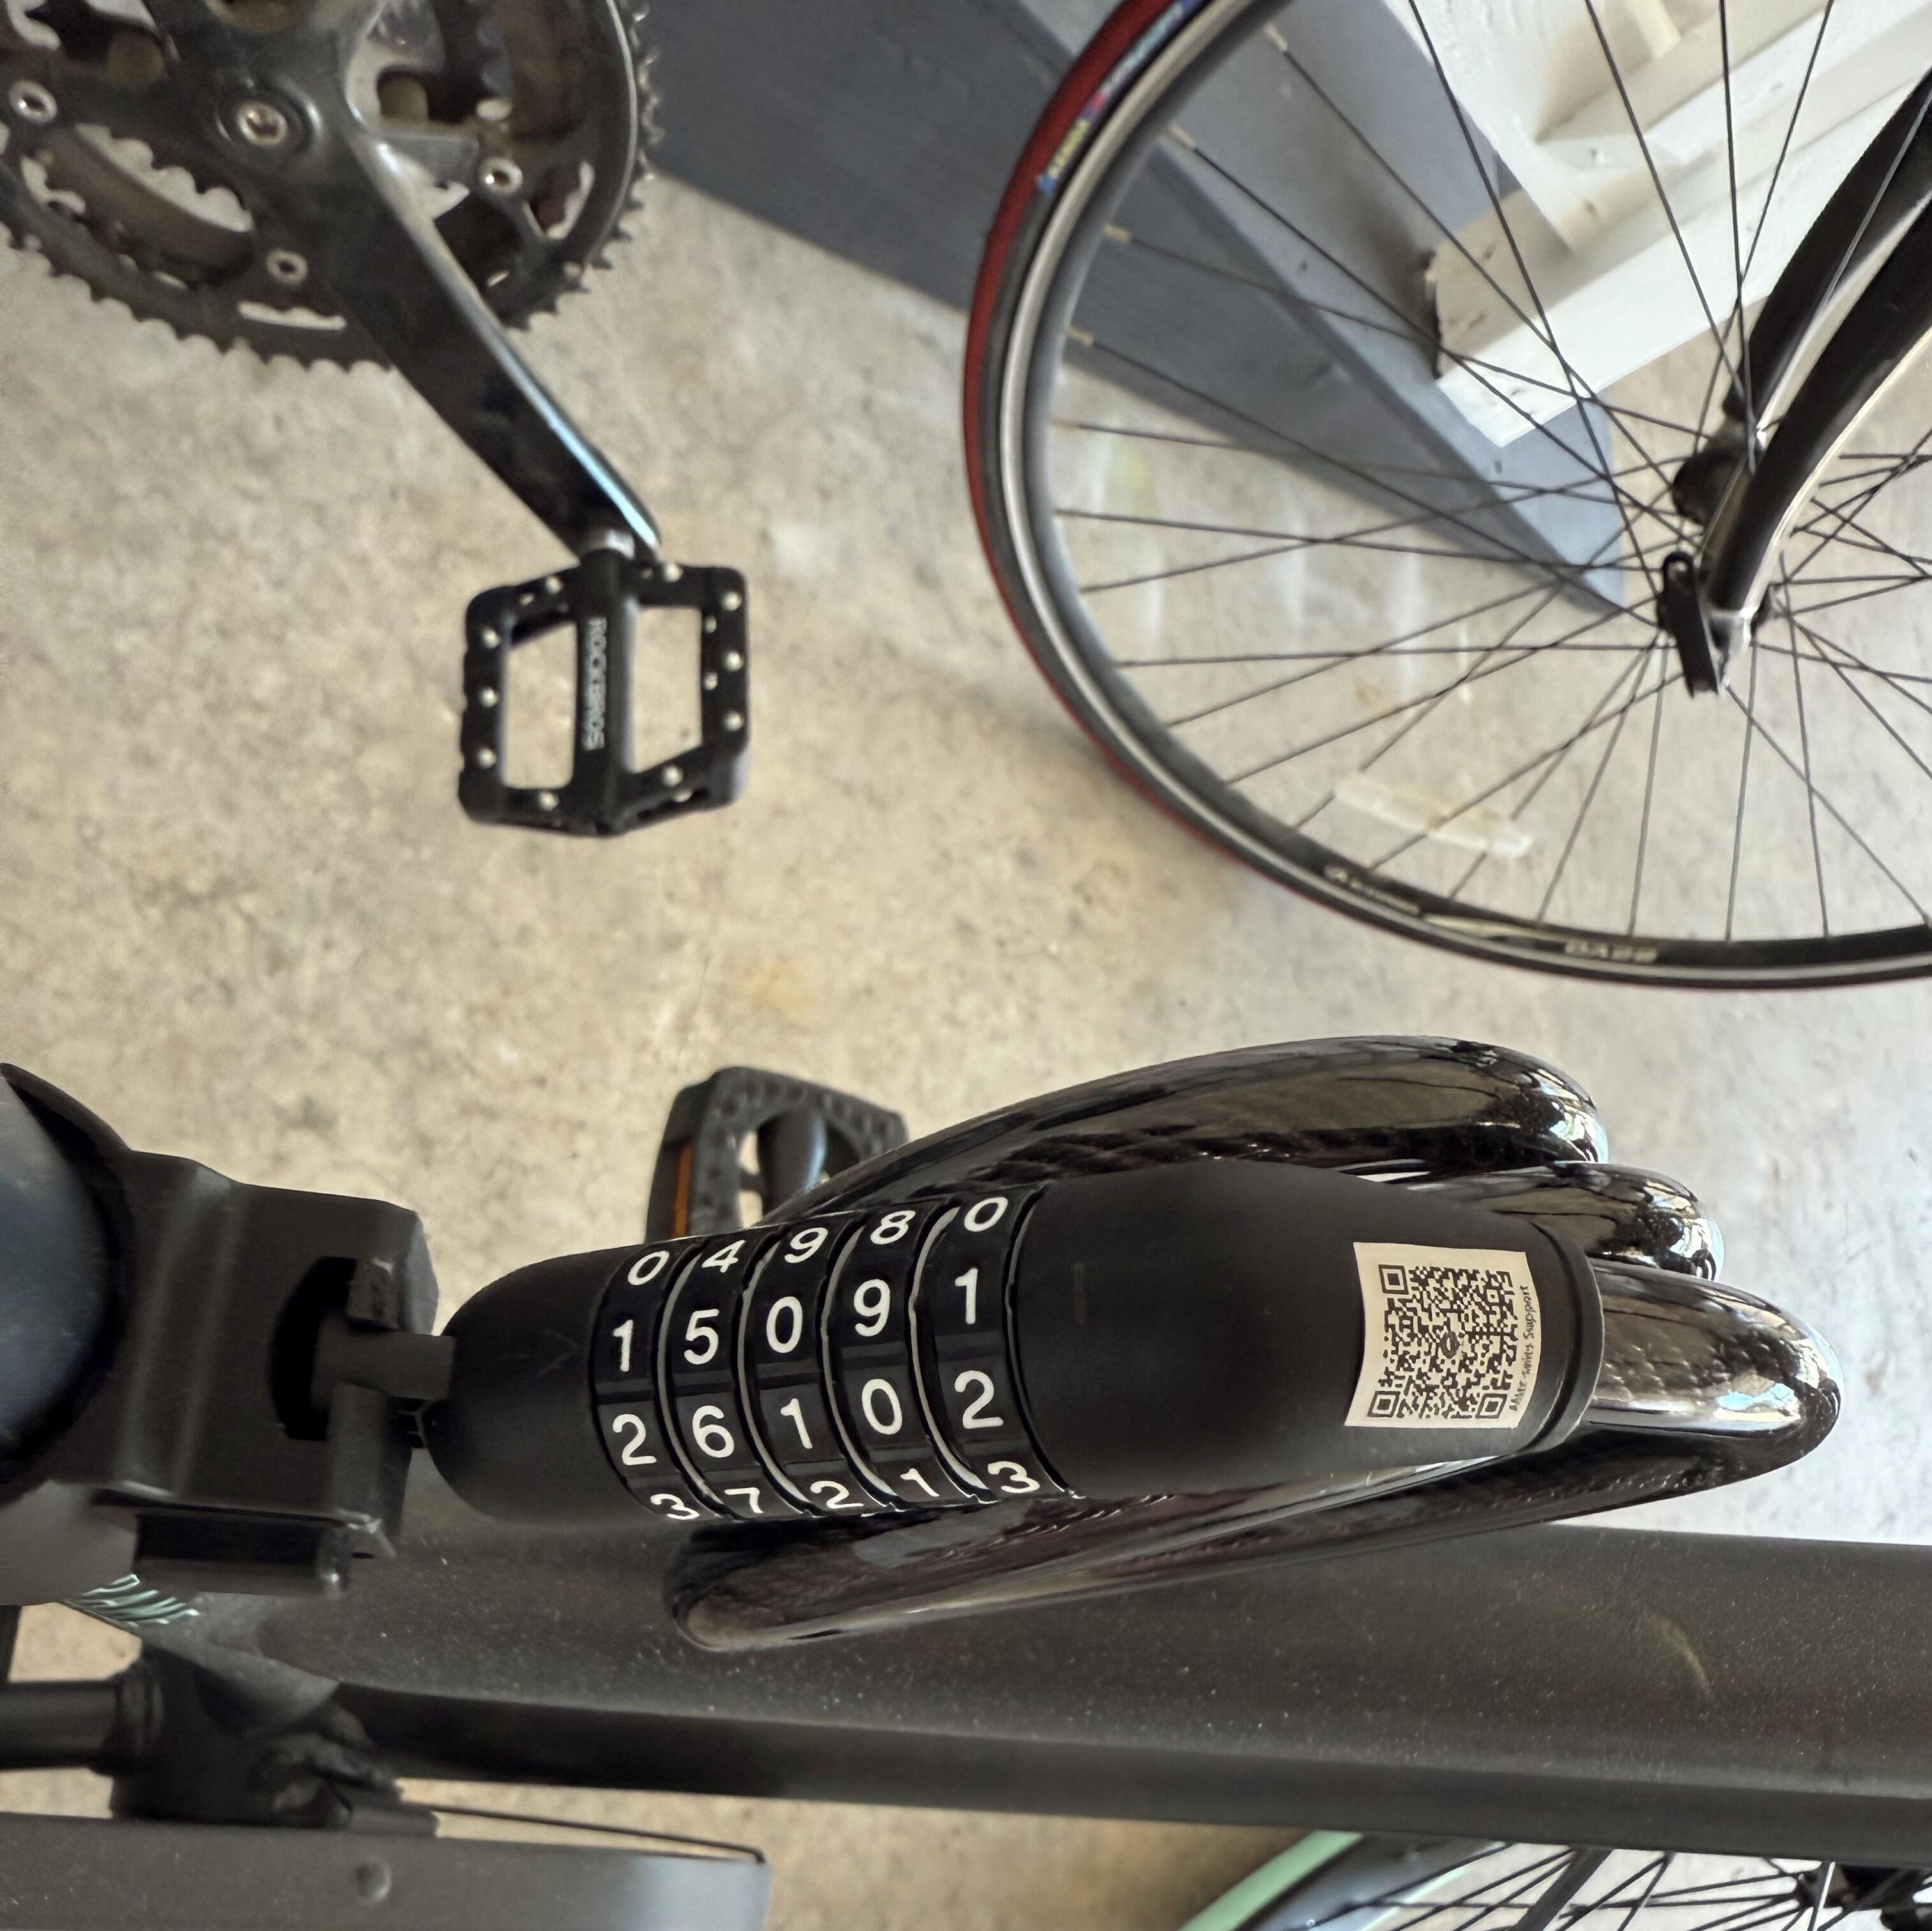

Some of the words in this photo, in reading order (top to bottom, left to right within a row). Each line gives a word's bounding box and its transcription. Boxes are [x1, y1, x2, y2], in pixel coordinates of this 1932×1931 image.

[627, 1250, 670, 1286] 0
[701, 1239, 746, 1274] 4
[784, 1226, 829, 1264] 9
[870, 1209, 917, 1246] 8
[963, 1196, 1009, 1233] 0
[613, 1319, 634, 1373] 1
[683, 1308, 720, 1366] 5
[765, 1295, 803, 1354] 0
[853, 1278, 891, 1338] 9
[954, 1267, 979, 1325] 1
[611, 1413, 657, 1467] 2
[691, 1405, 735, 1459] 6
[779, 1397, 813, 1450] 1
[861, 1378, 903, 1435] 0
[953, 1370, 1004, 1430] 2
[650, 1493, 701, 1521] 3
[723, 1486, 765, 1515] 7
[809, 1479, 865, 1510] 2
[899, 1467, 940, 1498] 1
[987, 1460, 1041, 1494] 3
